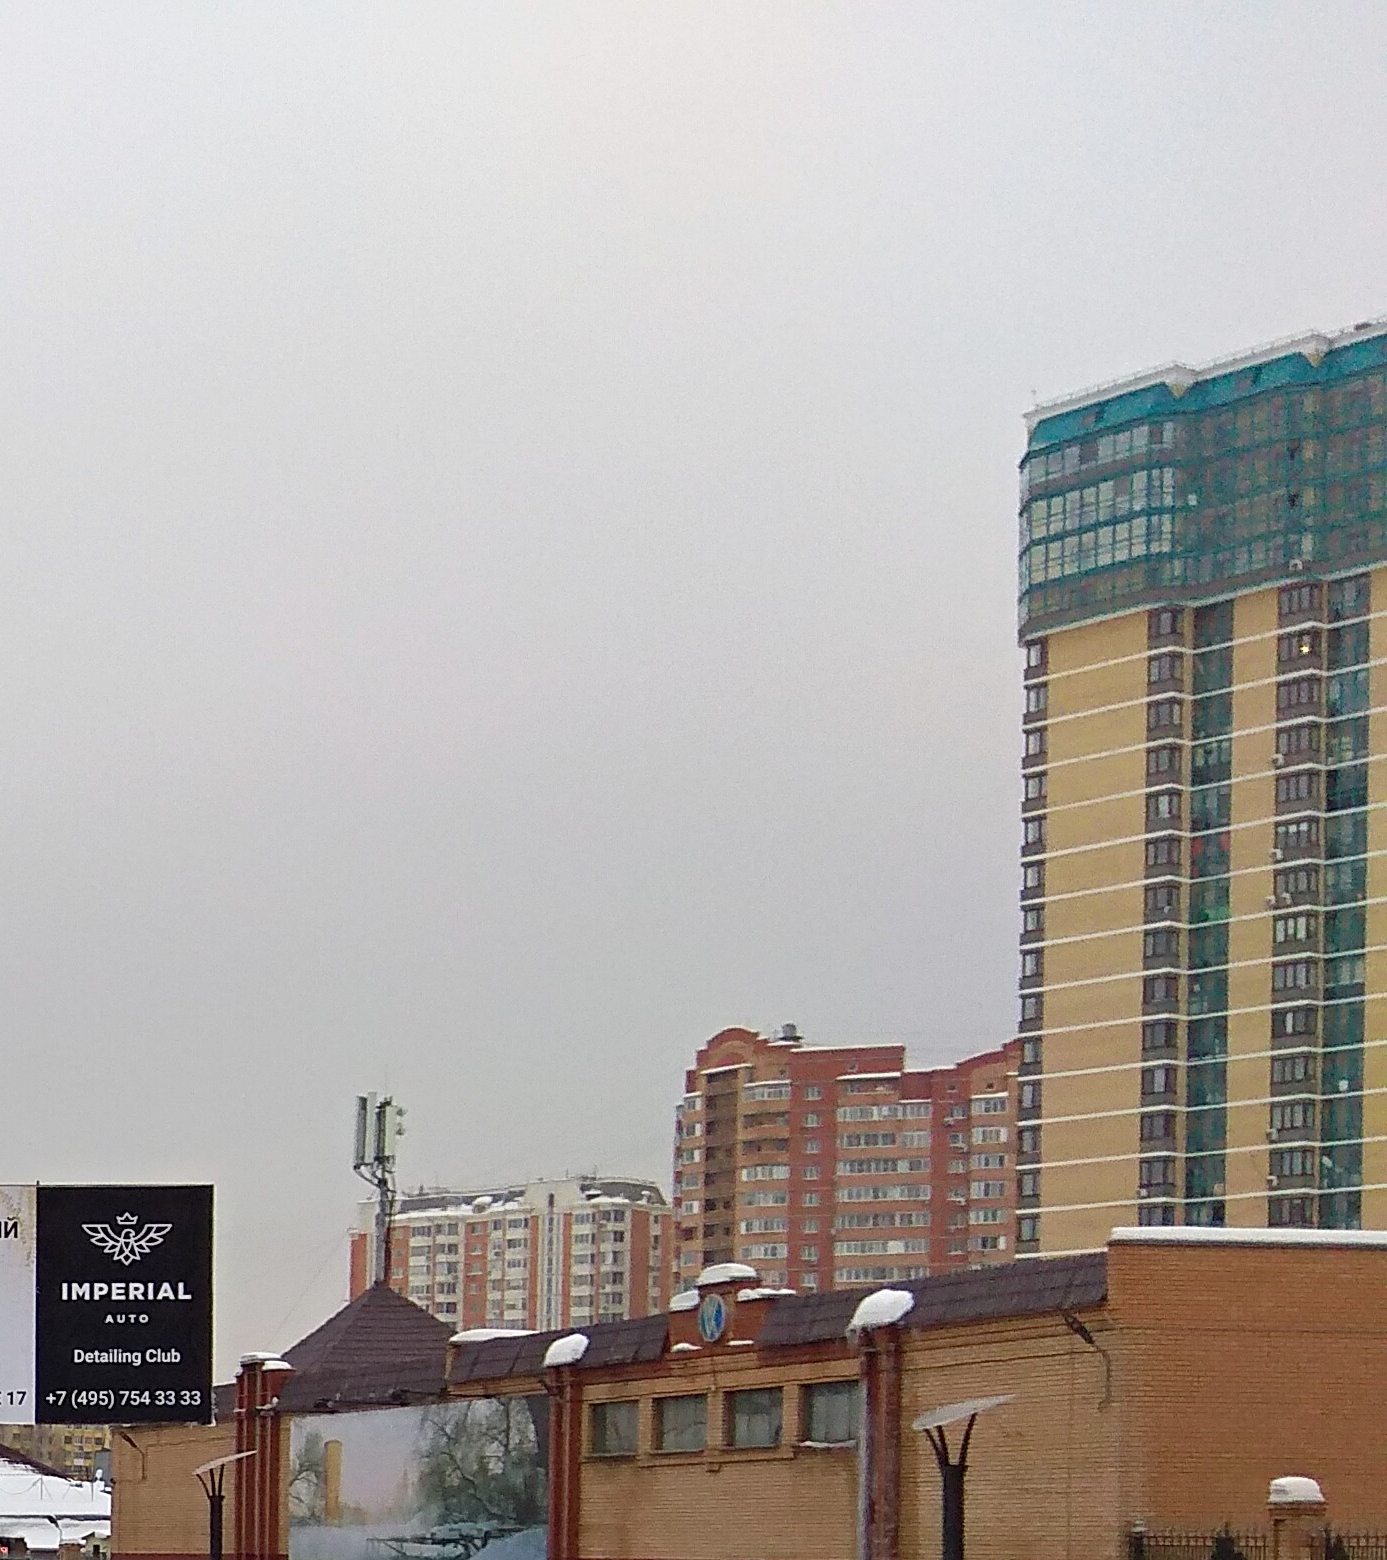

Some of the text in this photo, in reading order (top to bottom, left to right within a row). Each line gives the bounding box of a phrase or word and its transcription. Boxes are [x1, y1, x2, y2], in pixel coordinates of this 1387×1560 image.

[61, 1283, 192, 1301] IMPERIAL
[105, 1314, 150, 1324] AUTO
[73, 1348, 181, 1366] Detailing Club
[7, 1390, 27, 1405] 17
[46, 1389, 201, 1410] +7 (495) 754 33 33
